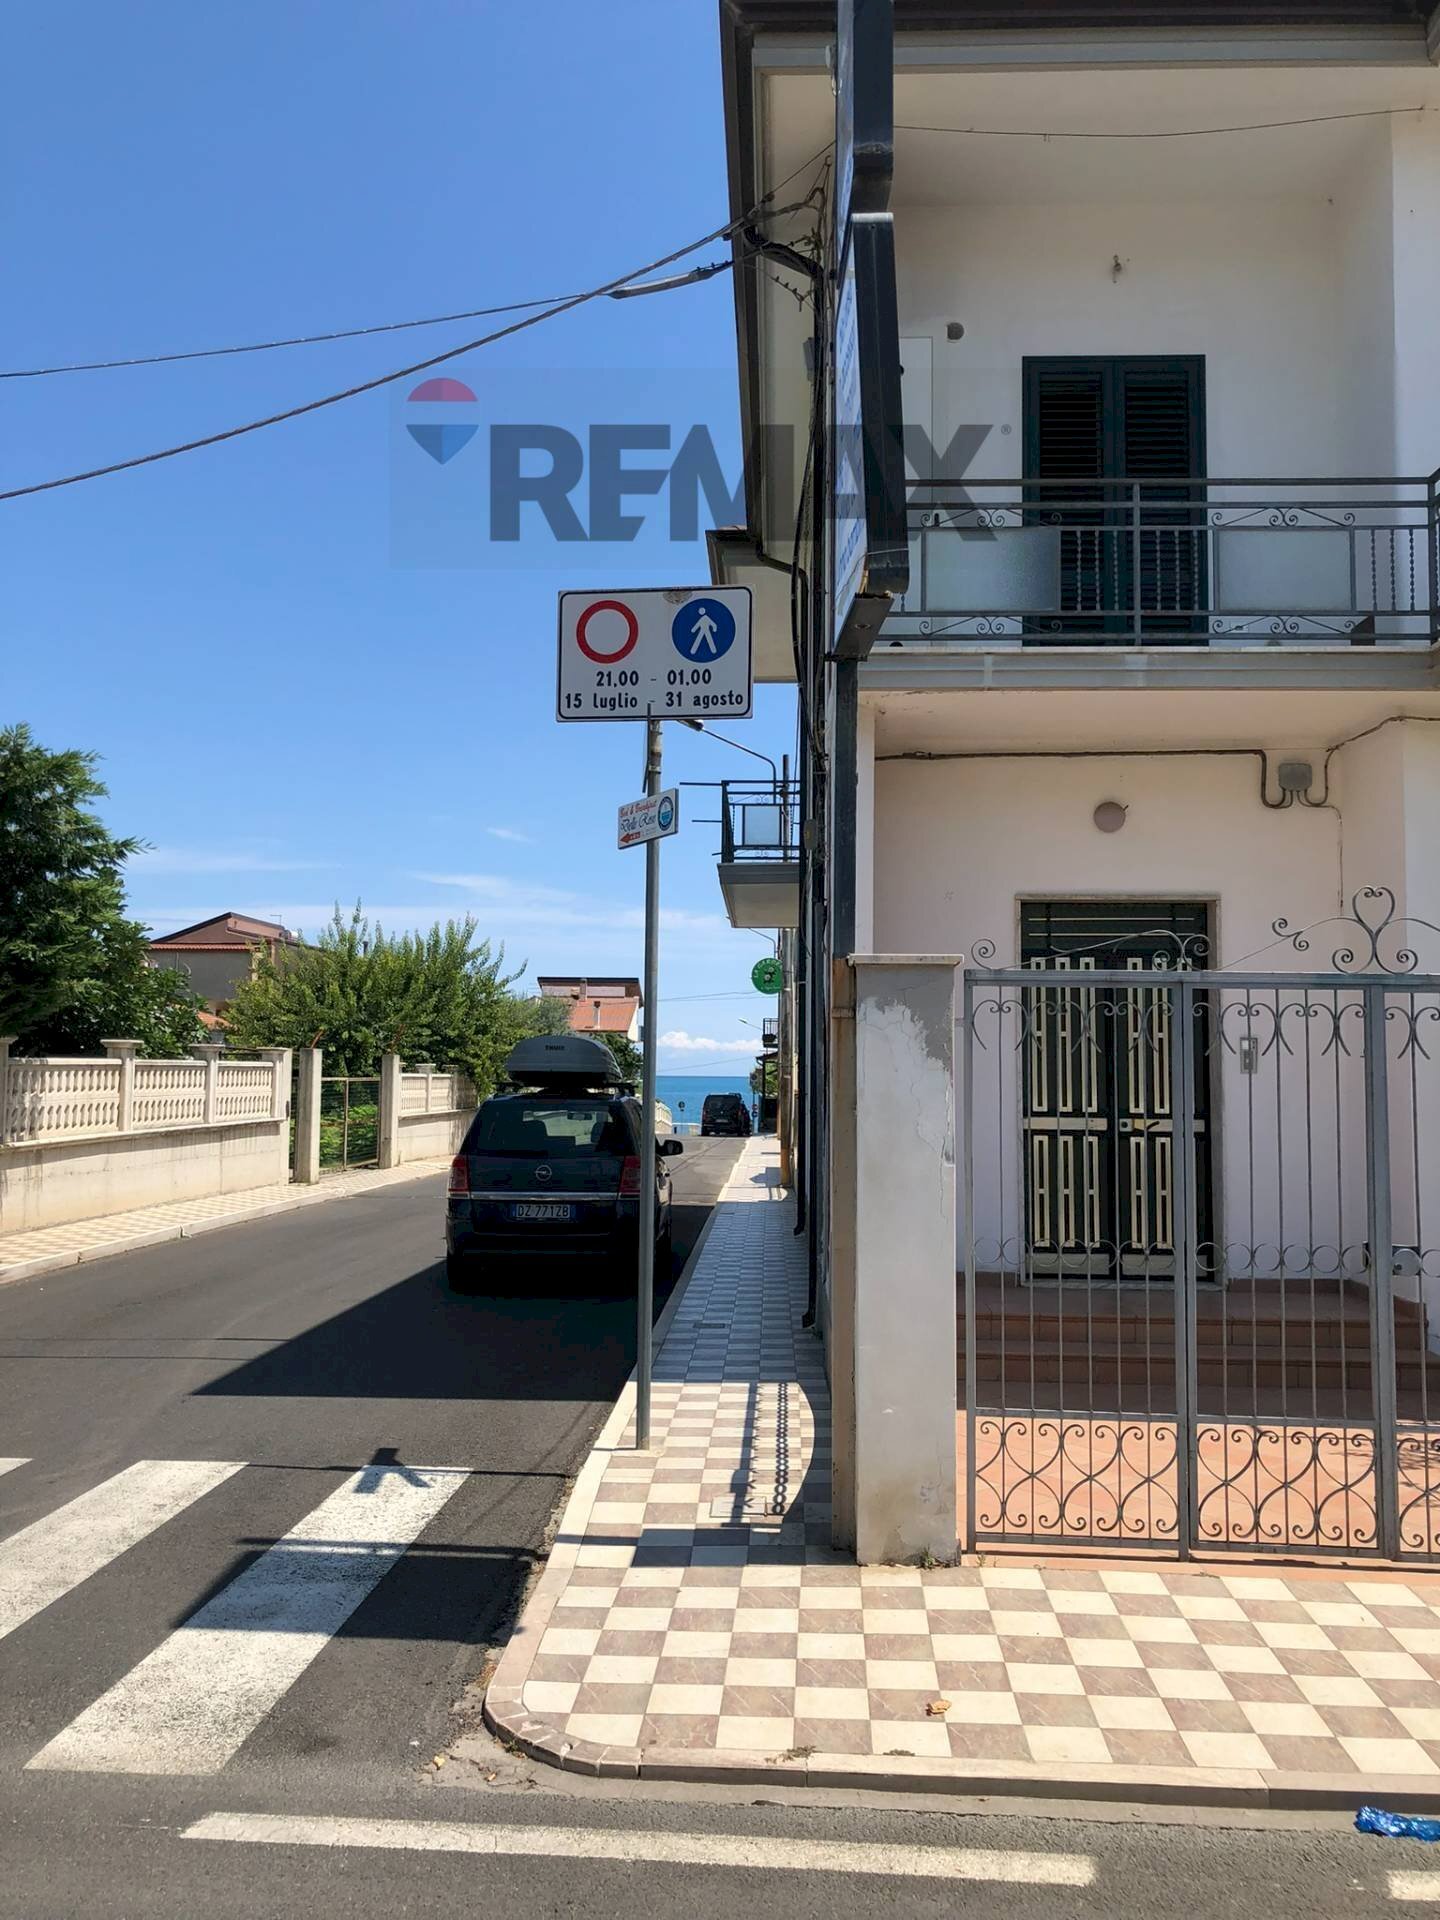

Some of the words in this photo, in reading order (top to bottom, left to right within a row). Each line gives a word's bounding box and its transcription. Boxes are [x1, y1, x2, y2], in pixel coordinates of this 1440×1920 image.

[565, 692, 582, 709] 15
[593, 692, 638, 711] luglio
[666, 691, 682, 707] 31
[693, 689, 743, 710] agosto
[517, 1205, 531, 1216] DZ
